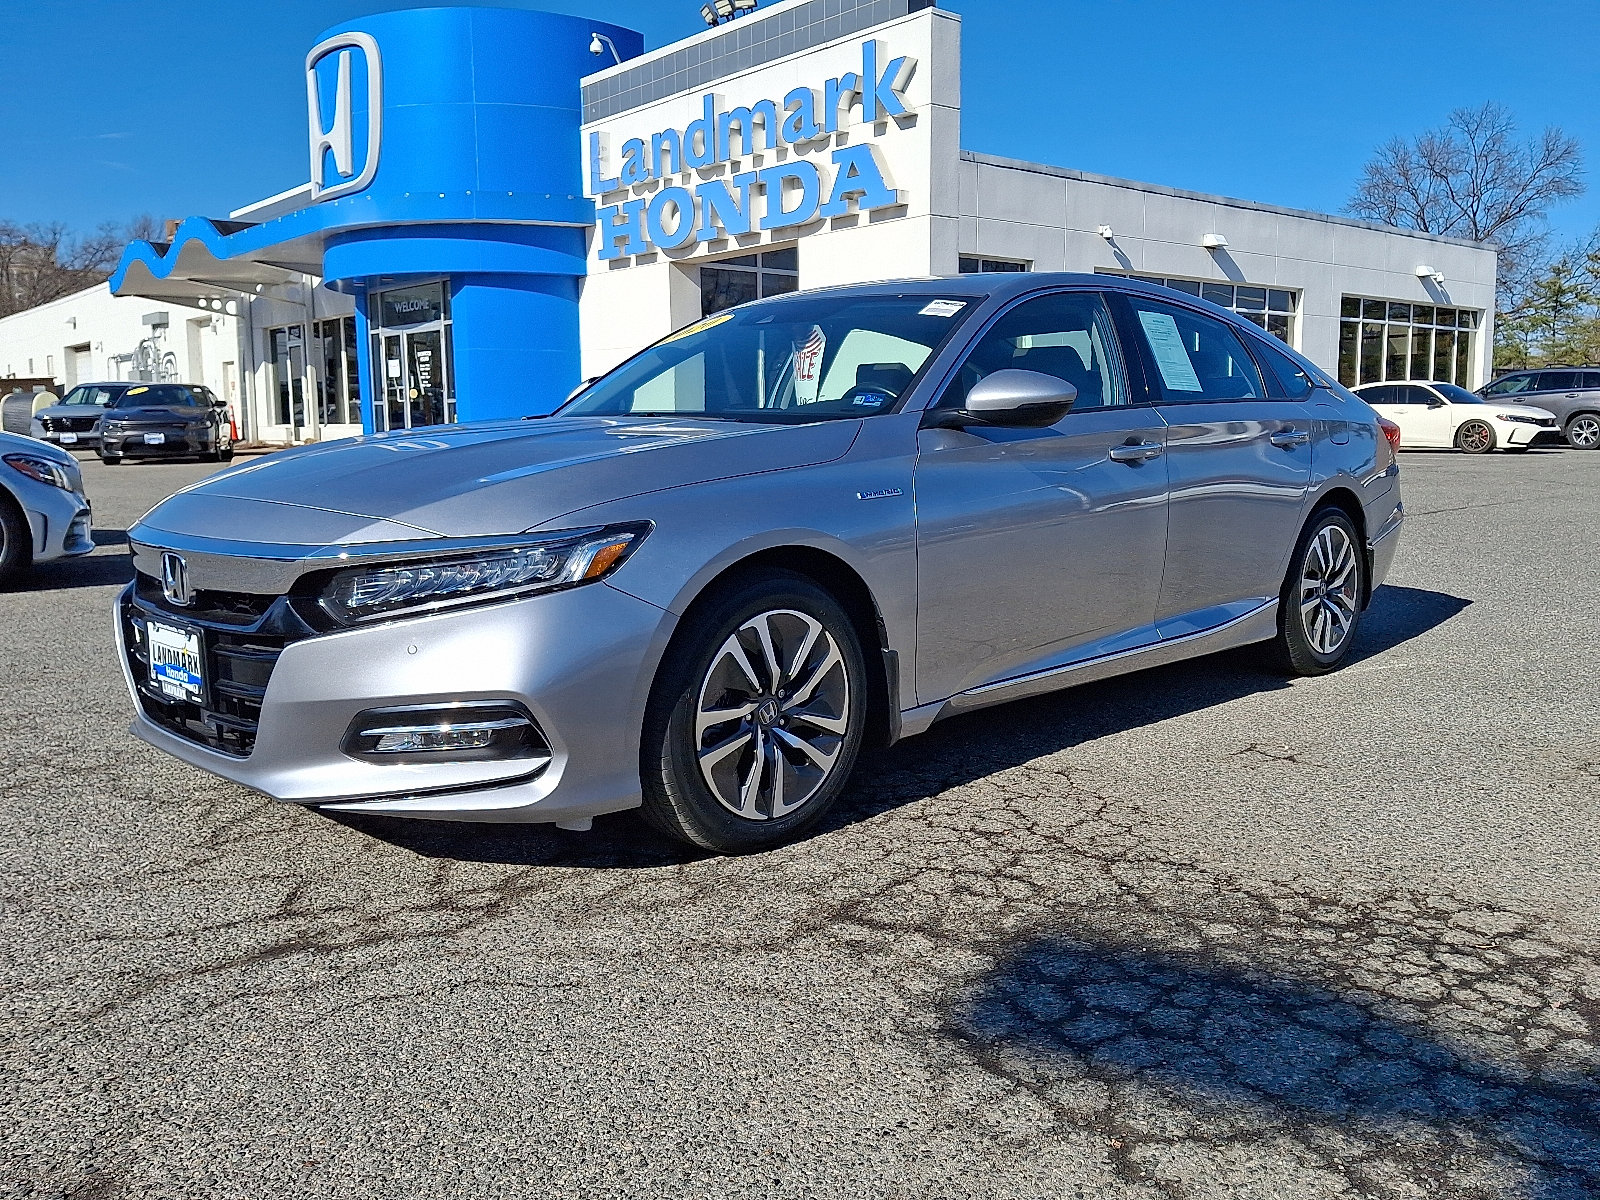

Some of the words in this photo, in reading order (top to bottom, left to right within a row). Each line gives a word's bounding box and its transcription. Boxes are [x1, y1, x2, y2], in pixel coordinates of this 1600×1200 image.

[590, 39, 914, 196] Landmark
[597, 143, 909, 260] HONDA
[394, 298, 430, 313] WELCOME
[152, 643, 200, 676] LANDMARK
[165, 666, 189, 682] Honda
